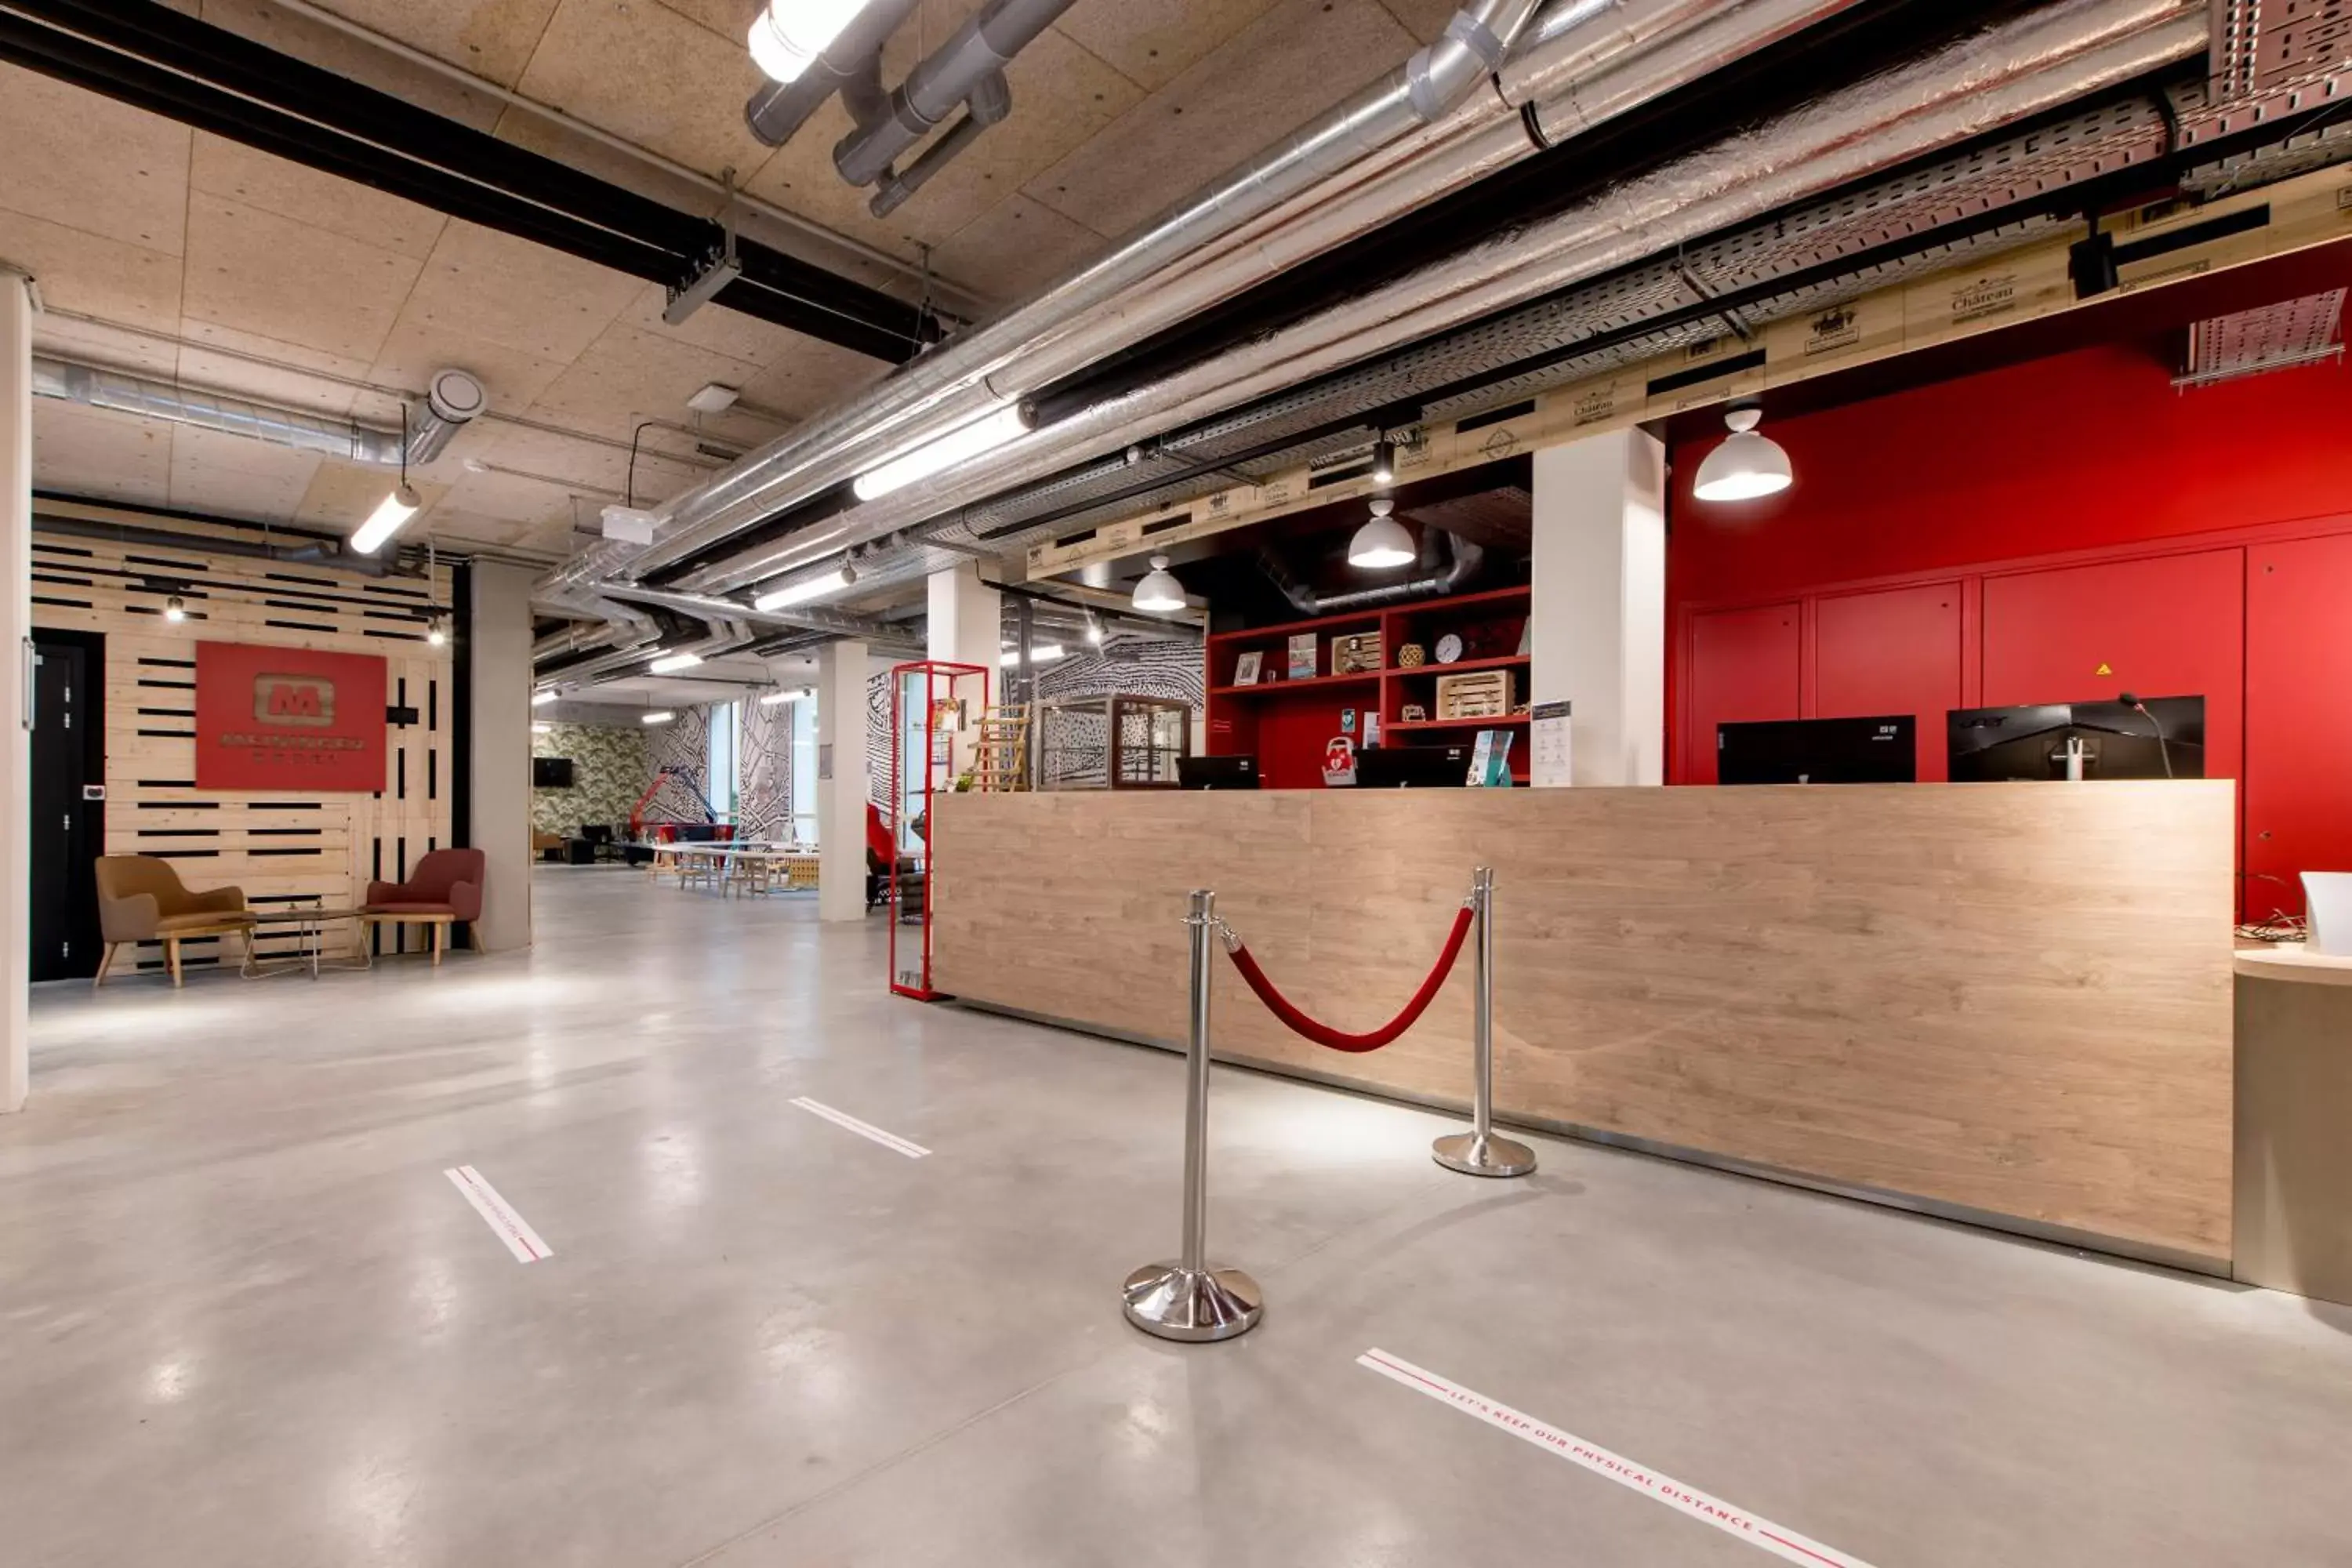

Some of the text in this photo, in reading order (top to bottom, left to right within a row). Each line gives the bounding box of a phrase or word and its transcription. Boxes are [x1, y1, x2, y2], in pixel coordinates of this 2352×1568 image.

[1450, 1392, 1753, 1530] LET'S KEEP OUR PHYSICAL DISTANCE
